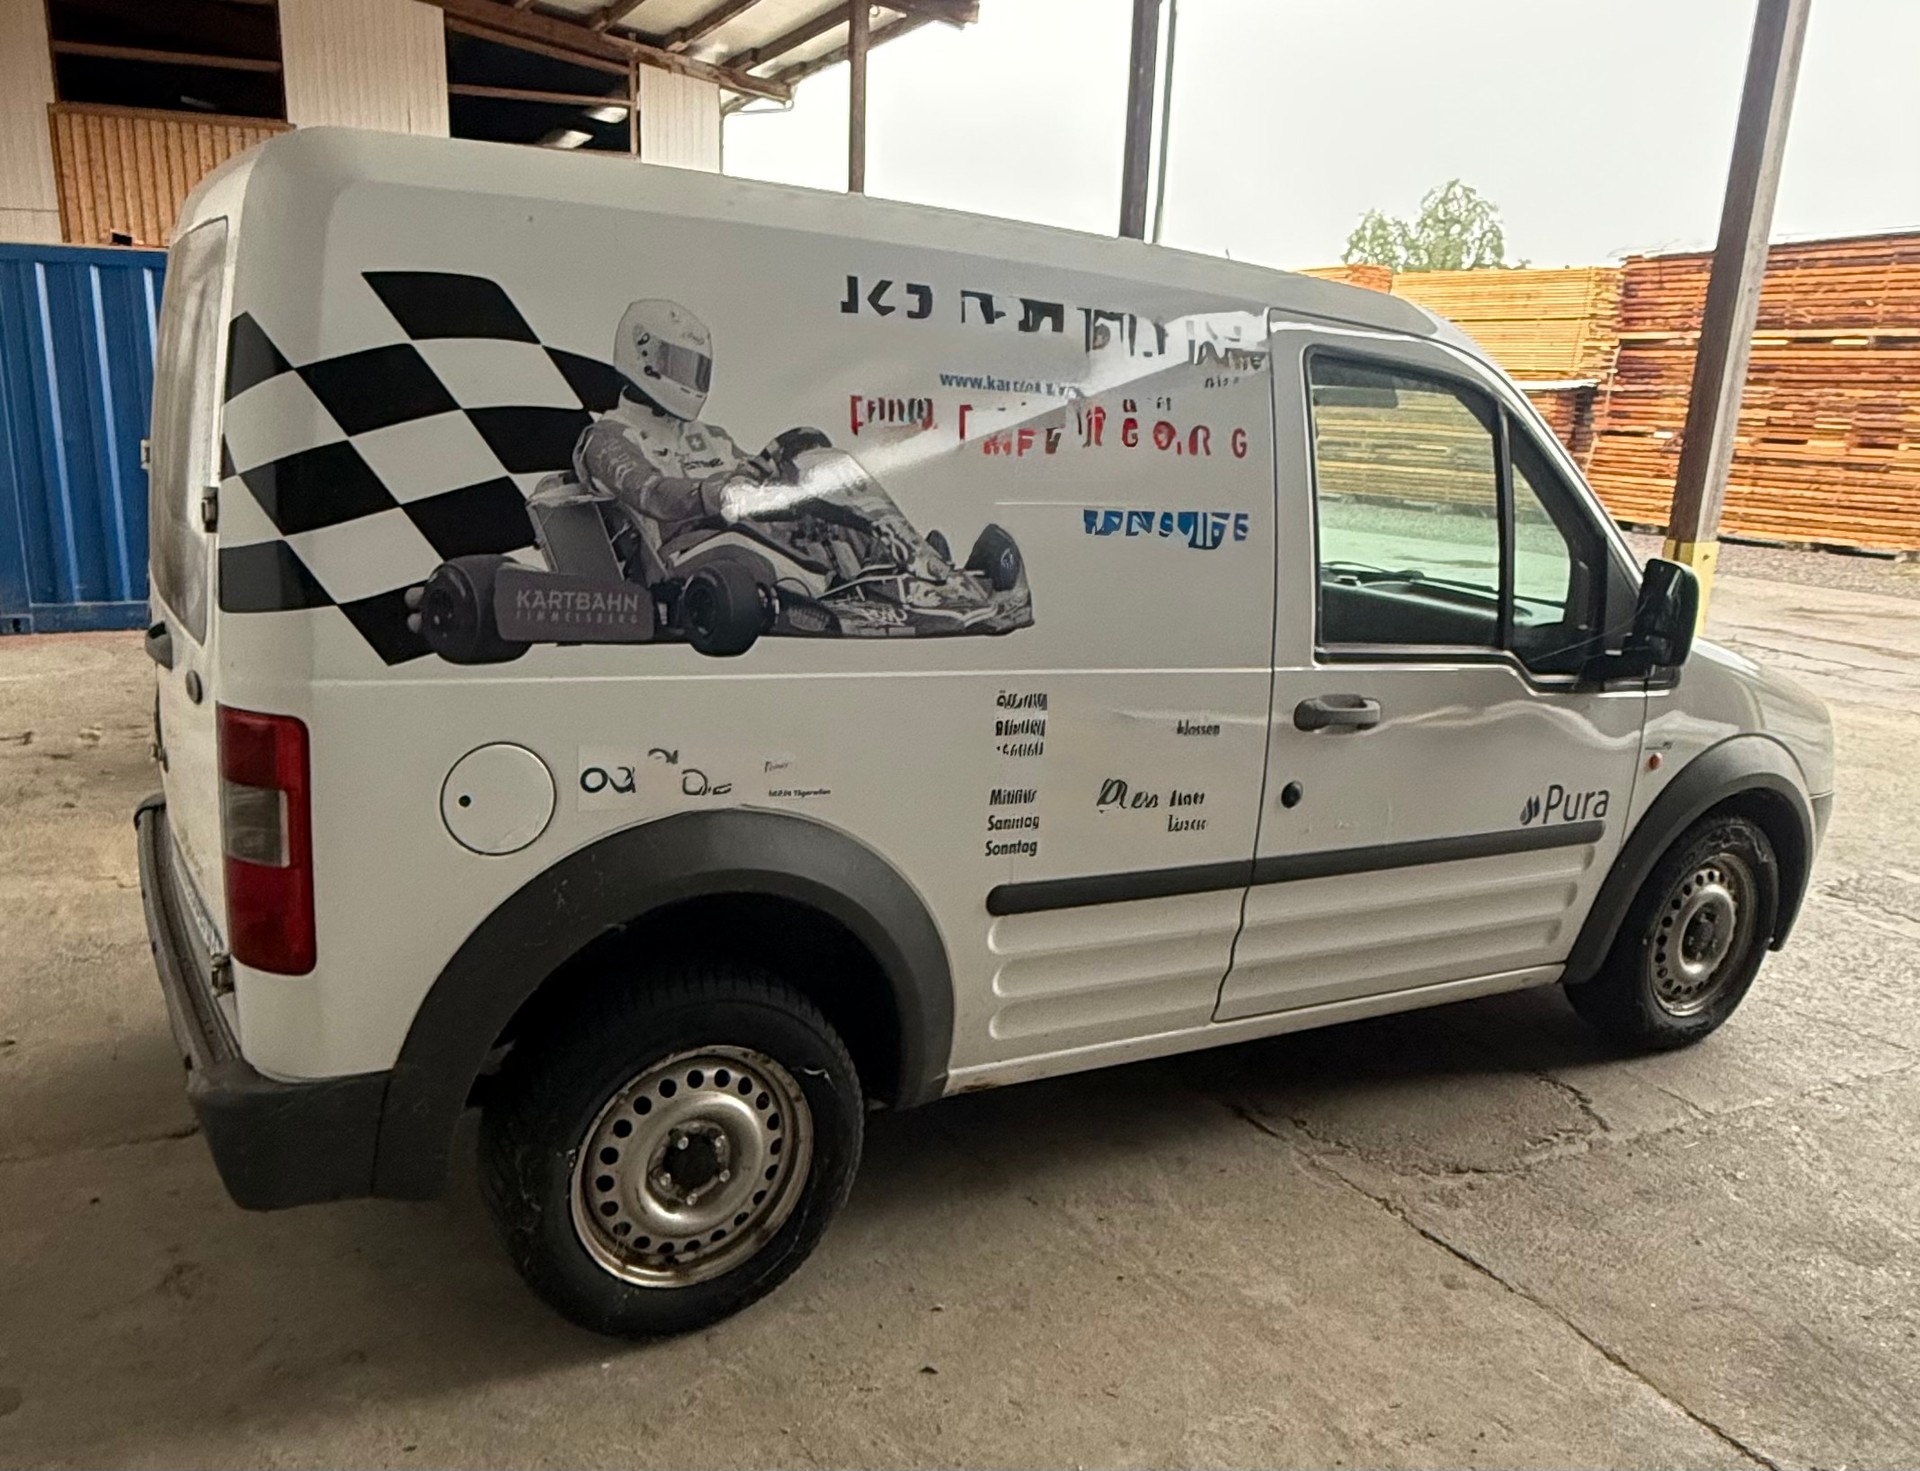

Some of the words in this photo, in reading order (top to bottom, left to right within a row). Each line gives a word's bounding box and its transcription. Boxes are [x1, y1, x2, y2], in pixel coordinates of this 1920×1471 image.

[516, 589, 639, 613] KARTBAHN
[1542, 784, 1610, 824] Pura
[985, 839, 1038, 857] Sonntag
